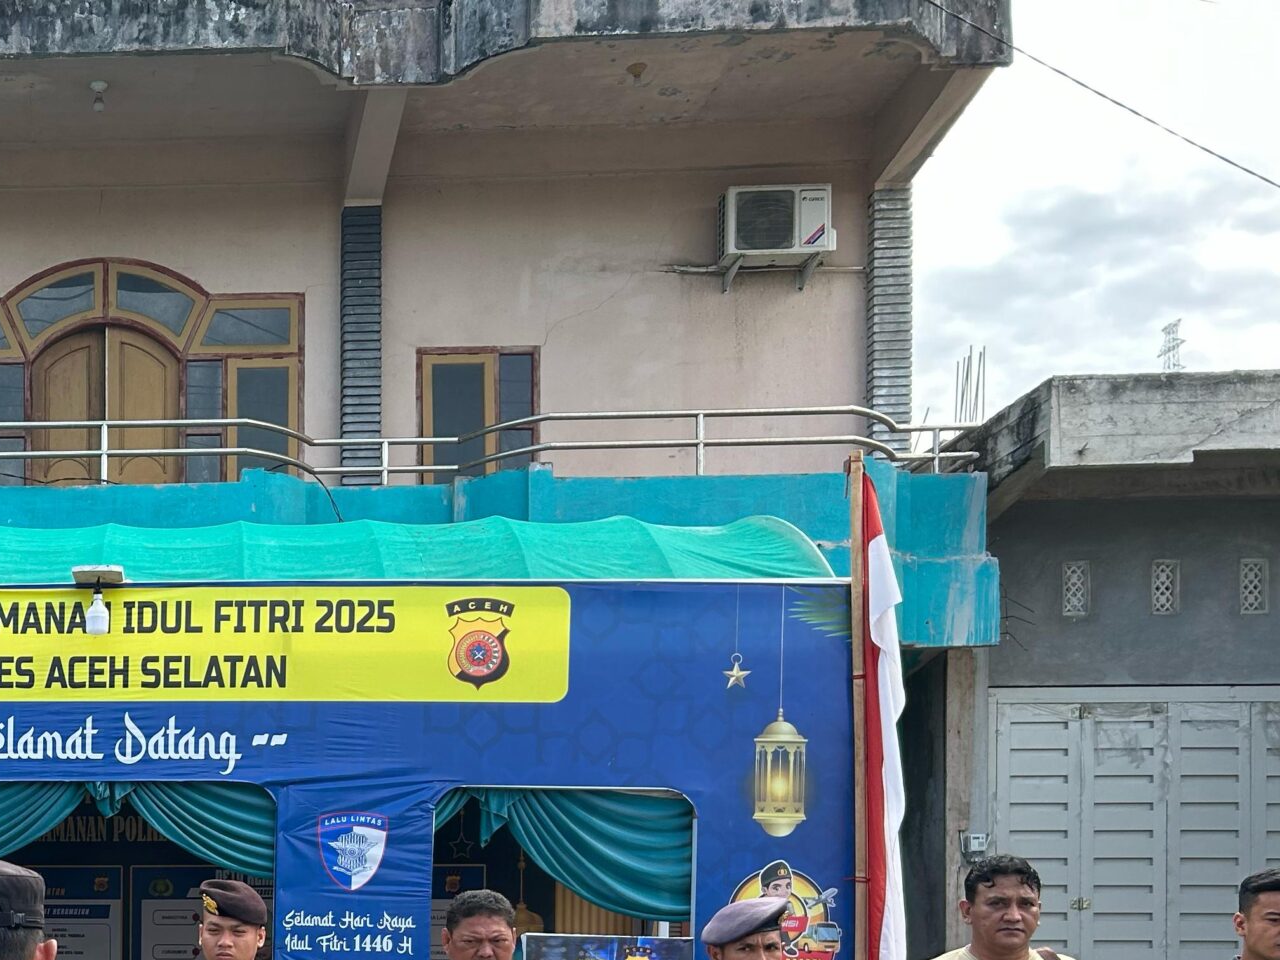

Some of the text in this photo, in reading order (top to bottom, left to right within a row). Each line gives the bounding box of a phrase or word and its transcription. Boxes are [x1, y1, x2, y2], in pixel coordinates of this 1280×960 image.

[123, 600, 203, 634] IDUL
[214, 599, 305, 633] FITRI
[315, 599, 396, 633] 2025
[45, 656, 129, 689] ACEH
[141, 655, 287, 689] SELATAN
[114, 711, 242, 776] Datang
[324, 816, 382, 826] LALU LINTAS
[339, 910, 374, 931] Hari
[377, 911, 416, 933] Raya
[285, 931, 414, 955] Idul Fitri 1446 H
